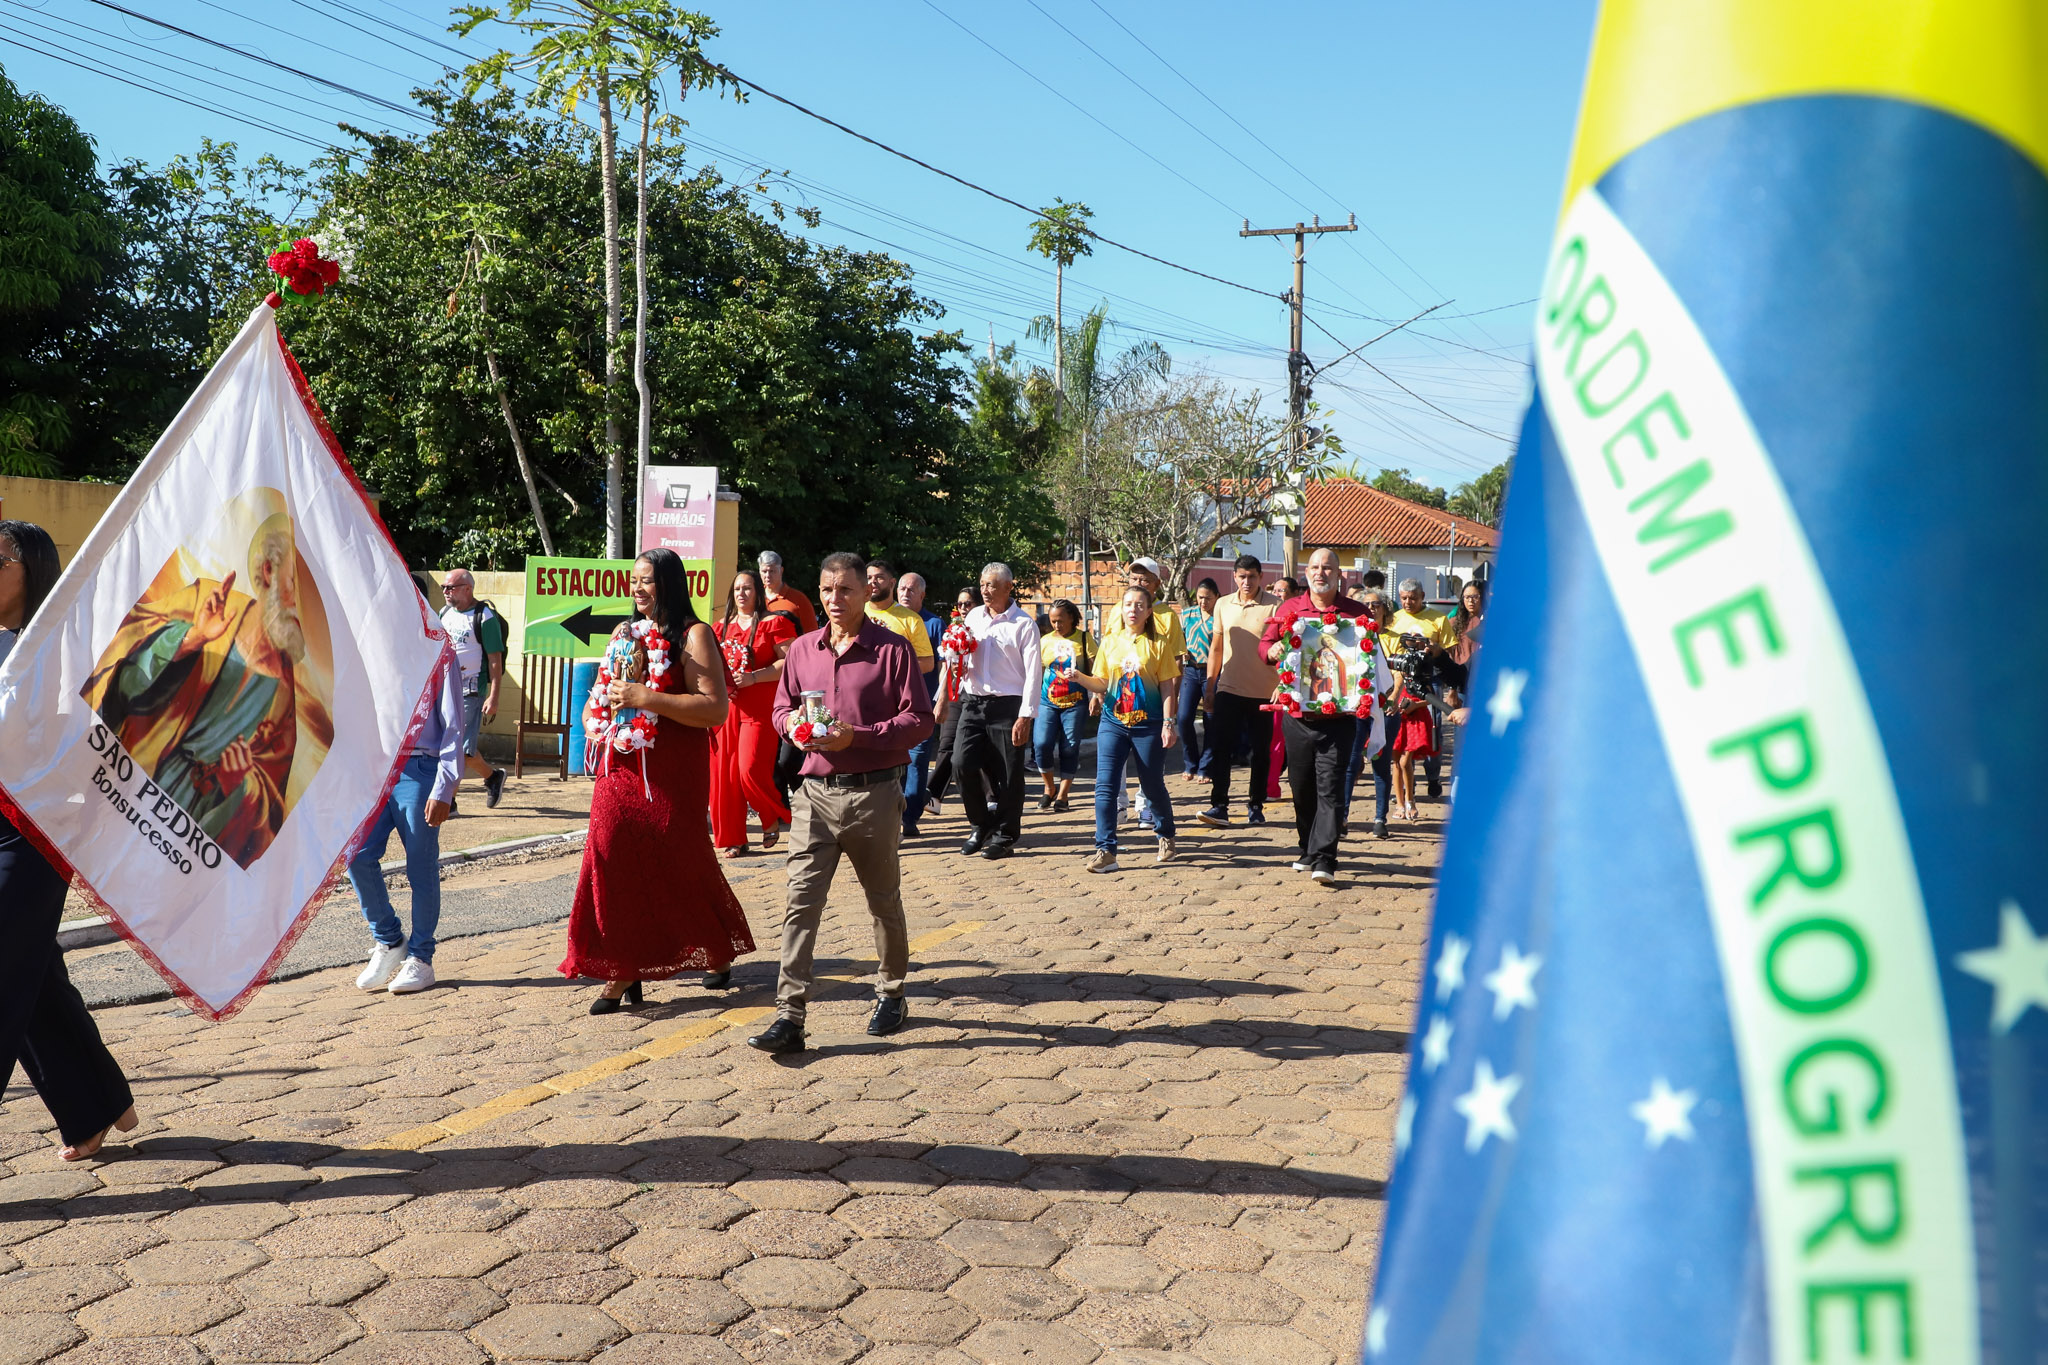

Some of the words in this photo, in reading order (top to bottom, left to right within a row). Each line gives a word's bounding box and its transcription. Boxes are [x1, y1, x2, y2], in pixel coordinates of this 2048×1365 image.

[1545, 234, 1735, 575] ORDEM
[1671, 585, 1787, 689] E
[536, 567, 709, 598] ESTACIONTO
[660, 537, 695, 548] Temos
[87, 724, 134, 782] SÃO
[135, 777, 222, 868] PEDRO
[91, 764, 192, 874] Bonsucesso
